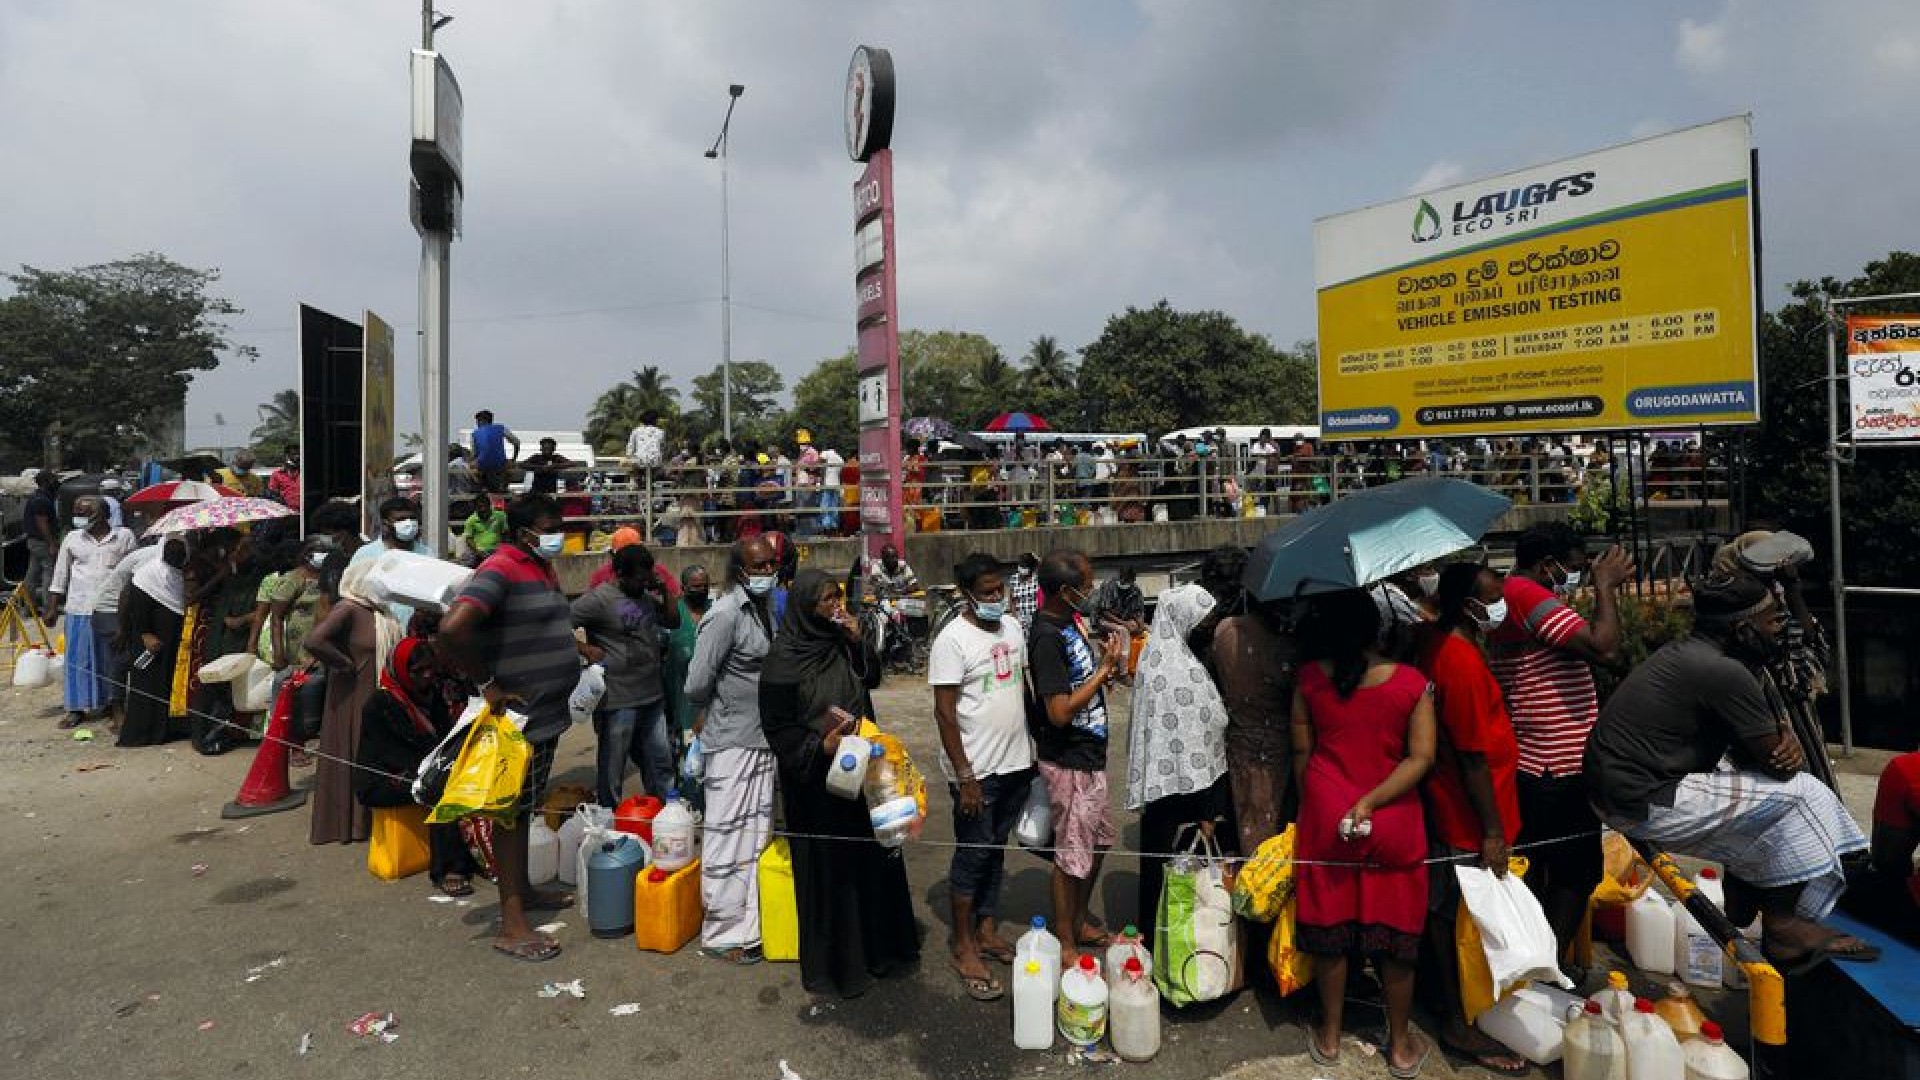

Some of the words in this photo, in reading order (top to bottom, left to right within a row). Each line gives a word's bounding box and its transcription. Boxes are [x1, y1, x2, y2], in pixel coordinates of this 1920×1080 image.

[1453, 171, 1596, 221] LAUGFS
[1453, 217, 1493, 236] ECO
[1505, 207, 1539, 226] SRI
[1397, 271, 1457, 295] වාහන
[1397, 310, 1457, 331] VEHICLE
[1463, 298, 1541, 323] EMISSION
[1548, 286, 1622, 311] TESTING
[1574, 324, 1603, 336] 7.00
[1574, 336, 1603, 348] 7.00
[1634, 390, 1745, 409] ORUGODAWATTA
